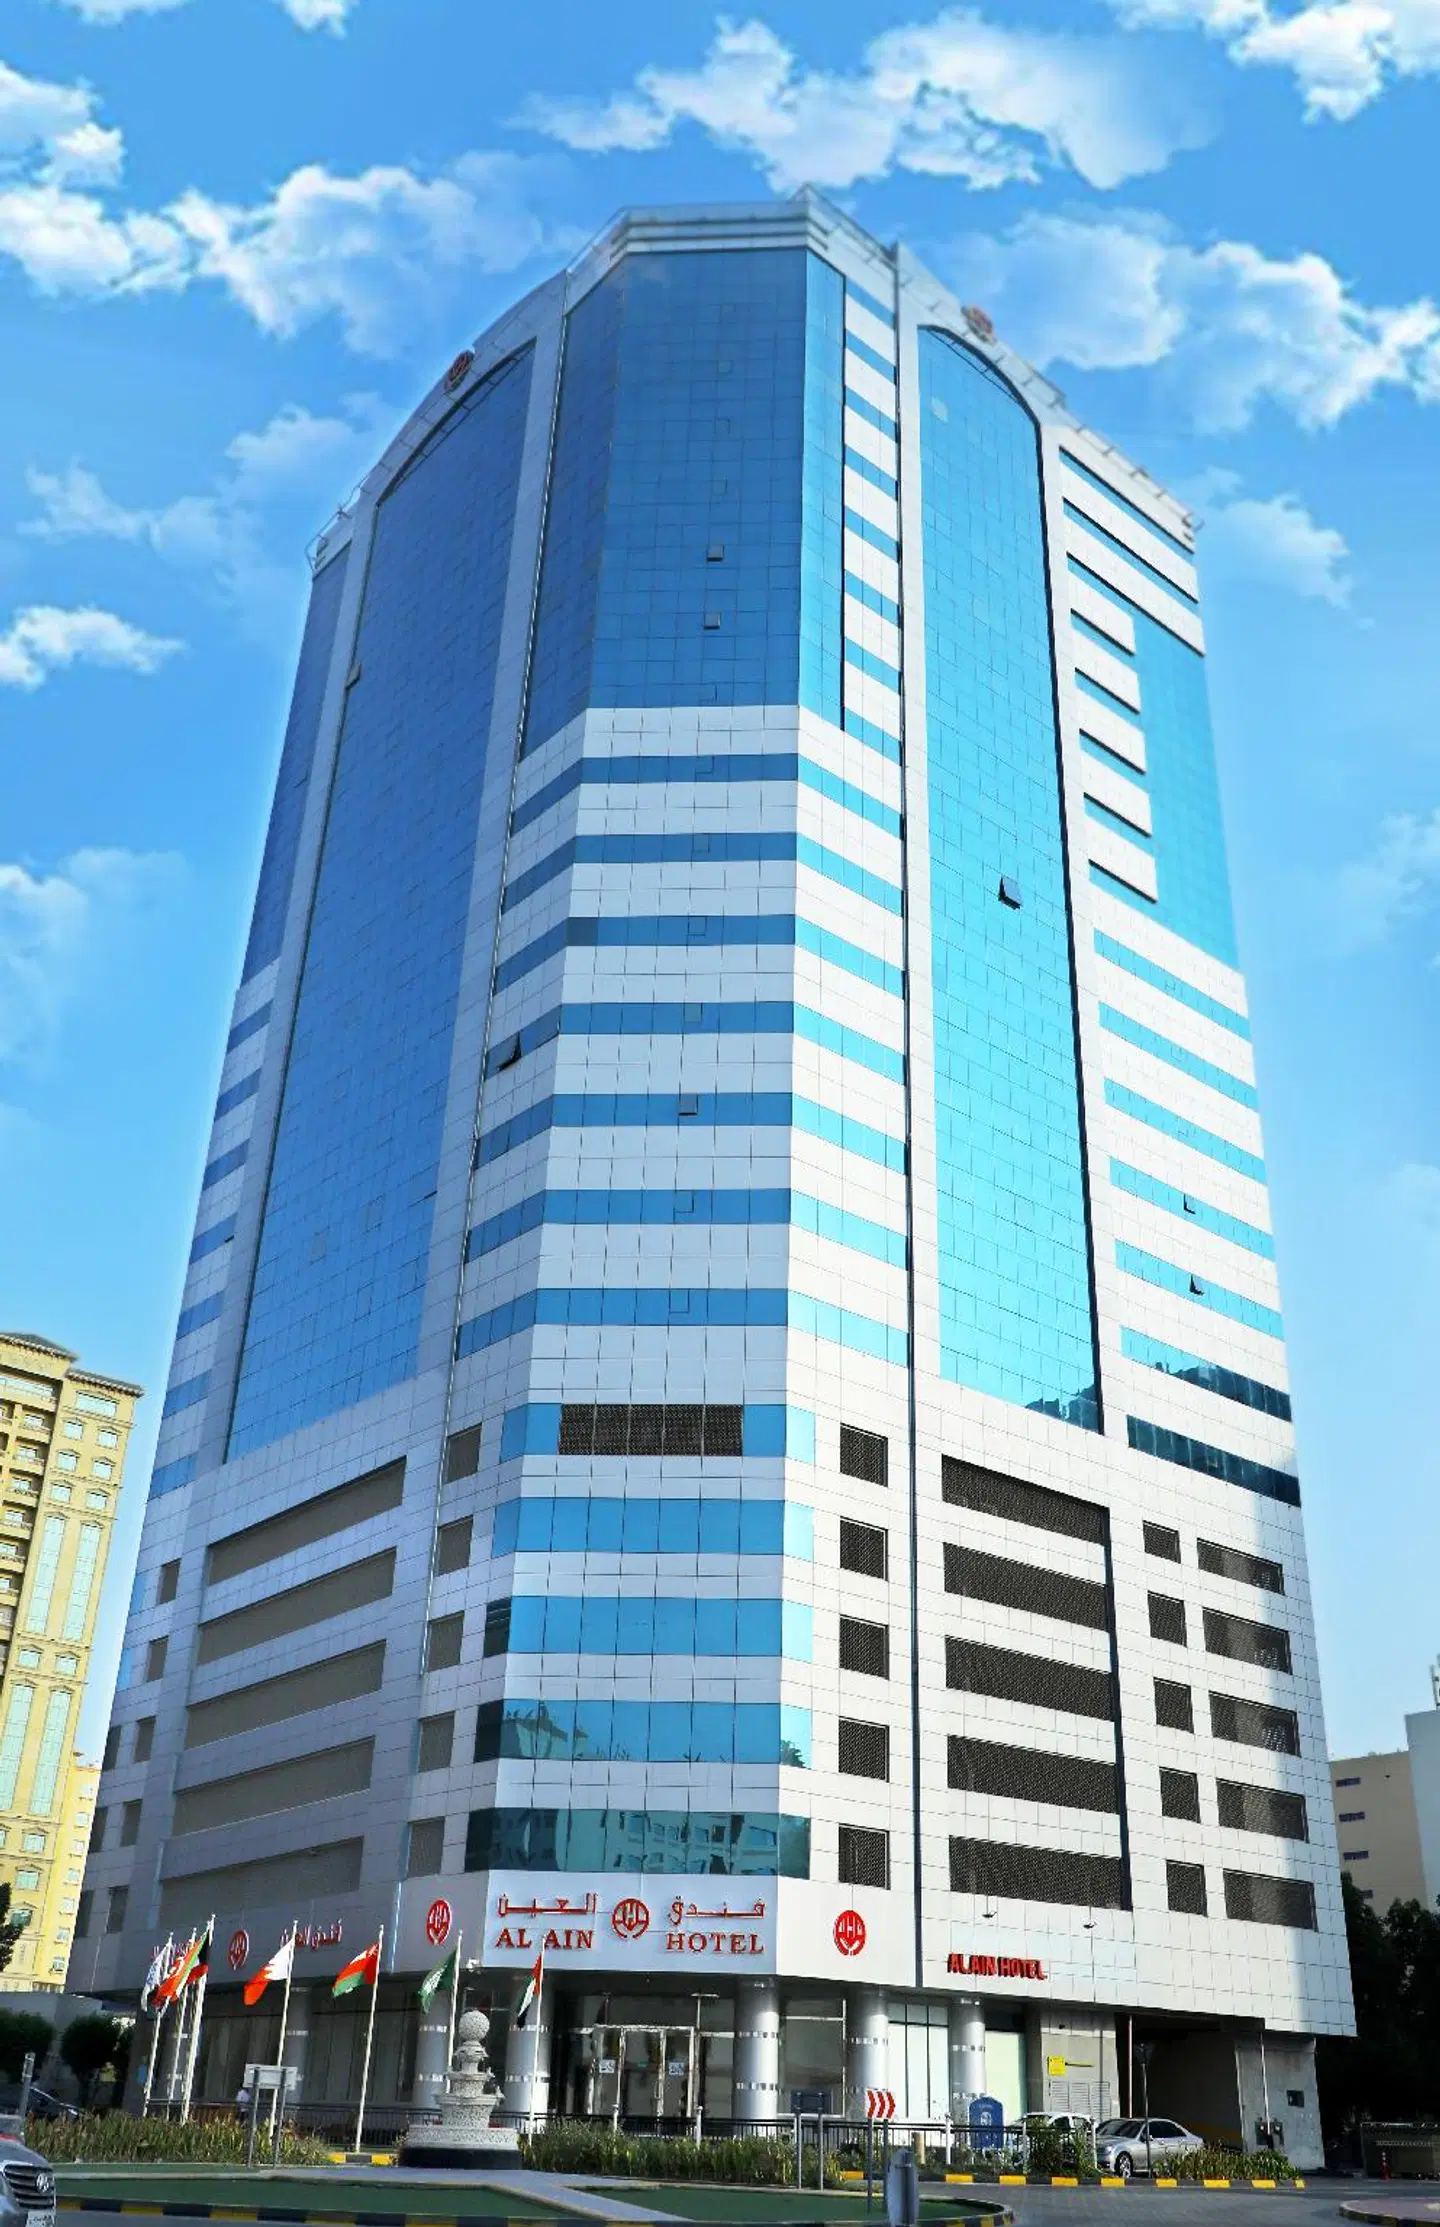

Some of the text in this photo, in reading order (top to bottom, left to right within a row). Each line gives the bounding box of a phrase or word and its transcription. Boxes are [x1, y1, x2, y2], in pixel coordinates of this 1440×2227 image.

[498, 1892, 765, 1926] فندق العين
[495, 1928, 765, 1955] AL AIN HOTEL
[997, 1957, 1048, 1980] HOTEL
